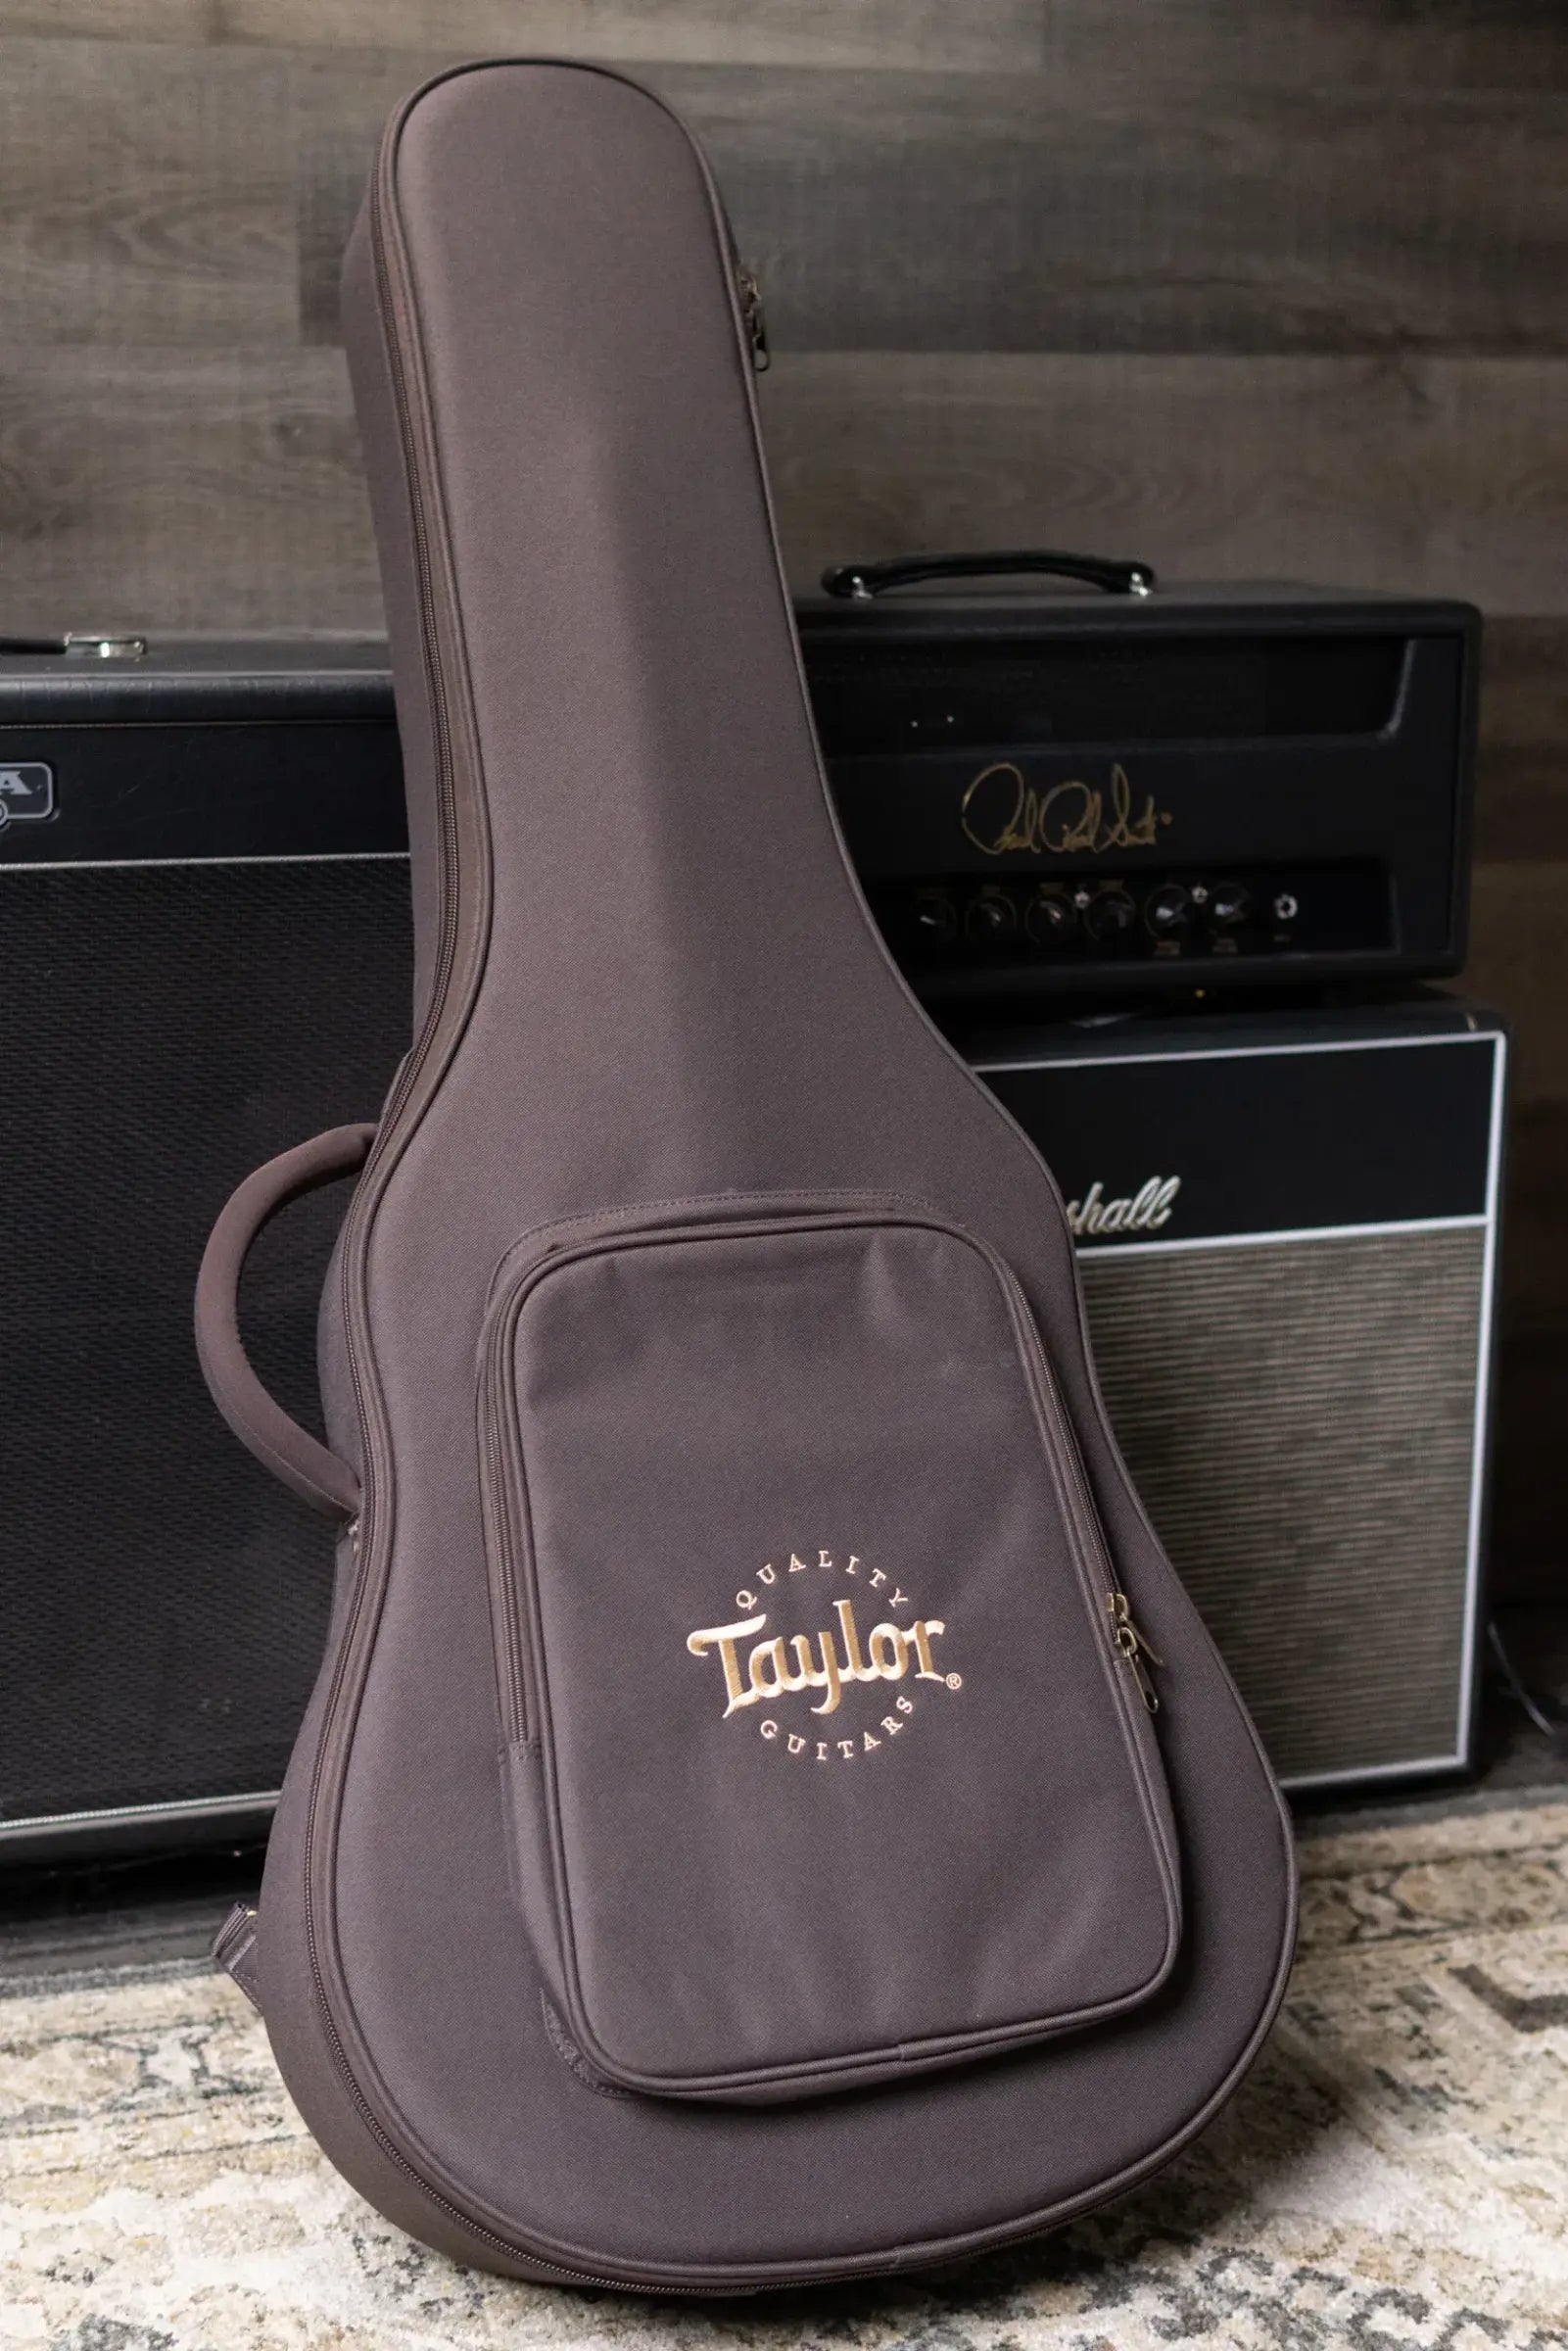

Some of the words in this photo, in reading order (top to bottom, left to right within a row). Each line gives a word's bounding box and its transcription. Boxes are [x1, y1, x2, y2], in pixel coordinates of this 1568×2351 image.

[1066, 1175, 1181, 1235] shall
[736, 1550, 908, 1609] QUALITY
[760, 1696, 913, 1760] GUITARS
